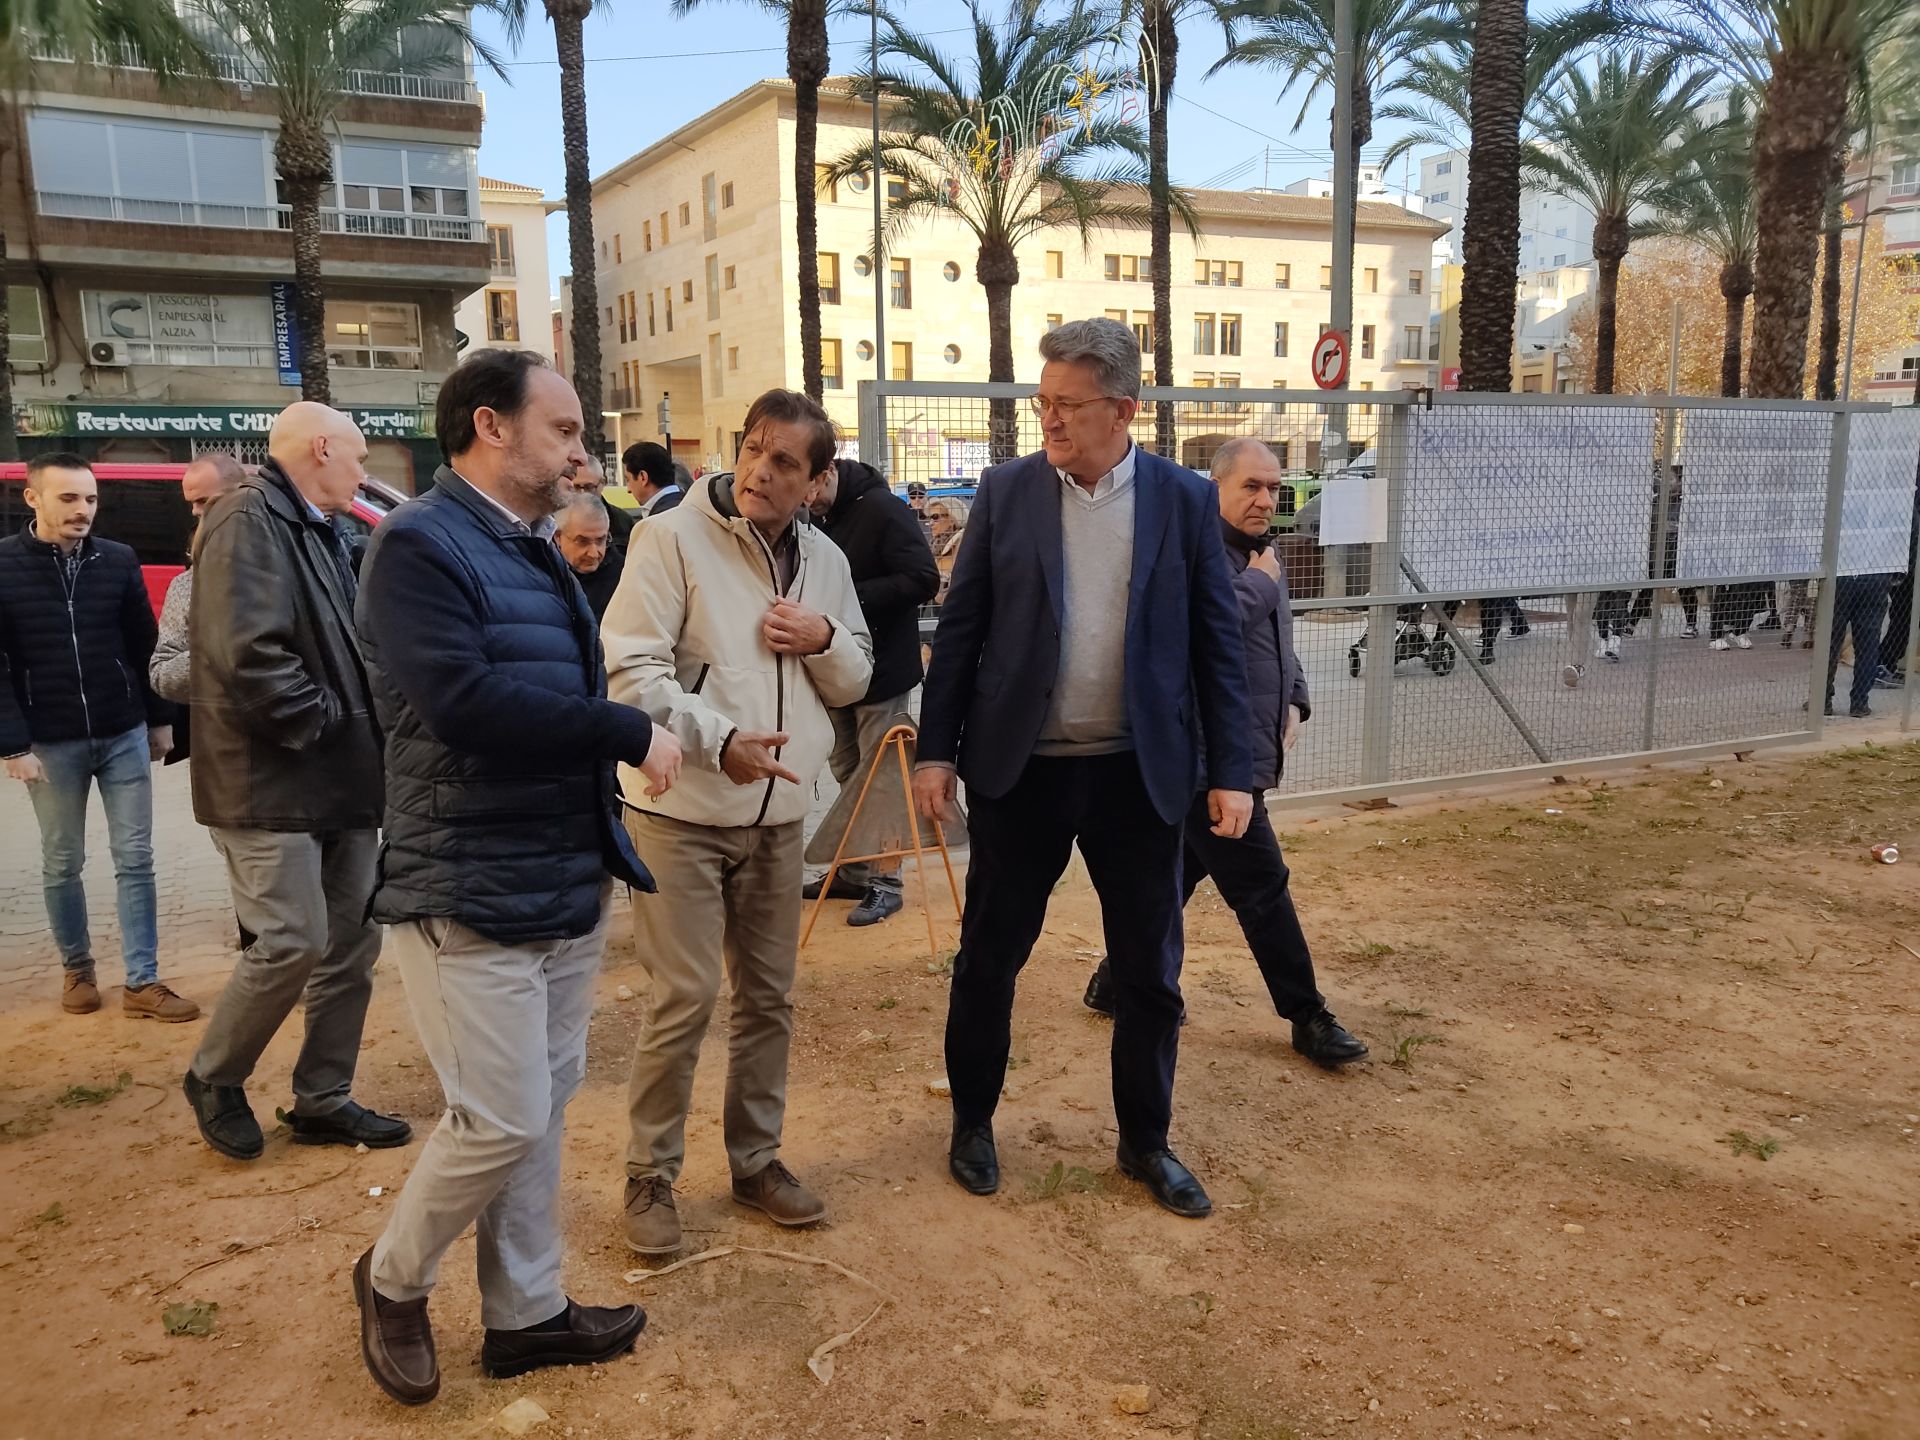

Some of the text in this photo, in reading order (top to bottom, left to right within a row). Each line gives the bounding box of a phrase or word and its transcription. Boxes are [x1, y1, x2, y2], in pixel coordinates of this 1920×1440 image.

[273, 283, 292, 369] EMPRESARIAL
[76, 411, 223, 432] Restaurante
[229, 412, 279, 431] CHIN
